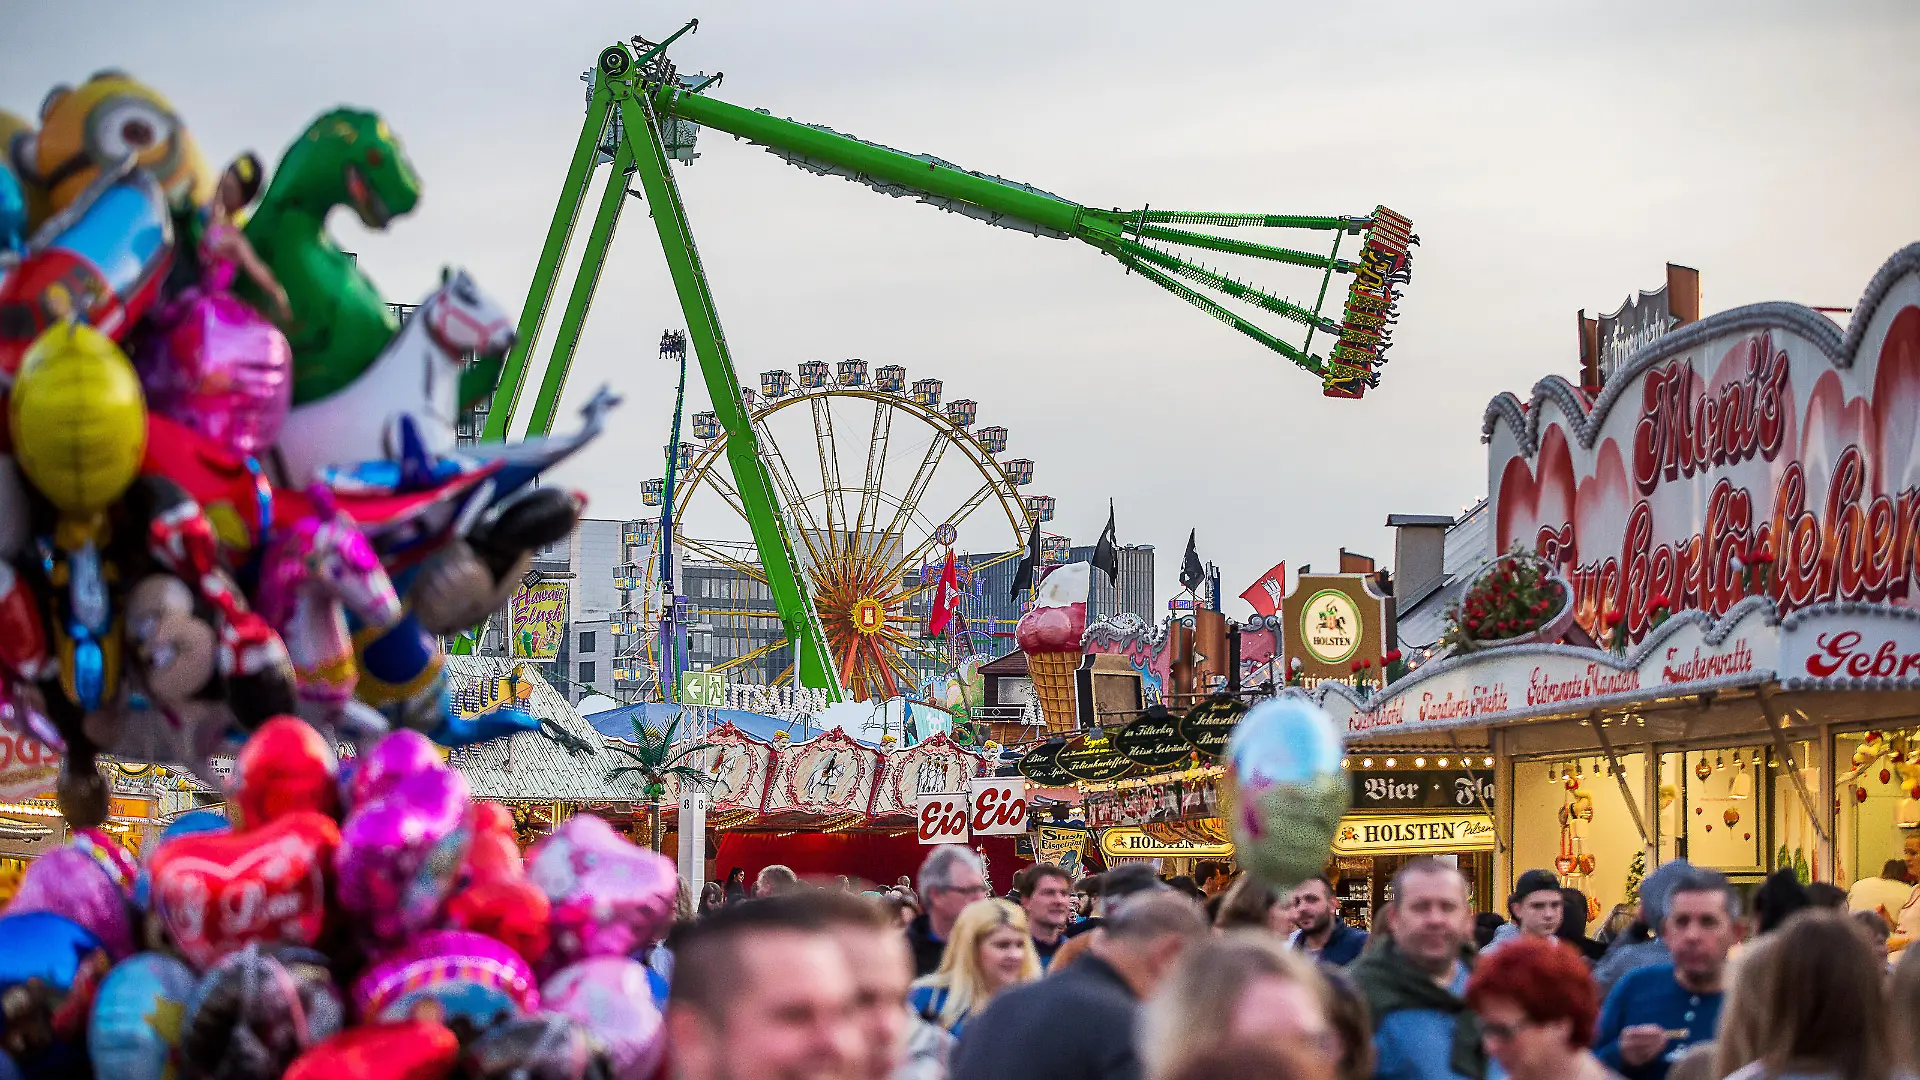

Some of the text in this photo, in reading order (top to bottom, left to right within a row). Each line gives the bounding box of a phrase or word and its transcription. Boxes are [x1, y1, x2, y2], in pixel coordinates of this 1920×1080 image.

[1634, 330, 1789, 496] Moni's
[512, 585, 565, 608] Hawaii
[513, 603, 563, 638] Slush
[1313, 636, 1351, 646] HOLSTEN
[1662, 637, 1753, 685] Zuckerwatte
[1026, 753, 1049, 764] Bier
[1364, 778, 1419, 800] Bier
[683, 798, 690, 810] 8
[972, 787, 1026, 831] Eis
[919, 801, 967, 841] Eis
[1041, 829, 1083, 841] Slush
[1364, 823, 1456, 843] HOLSTEN
